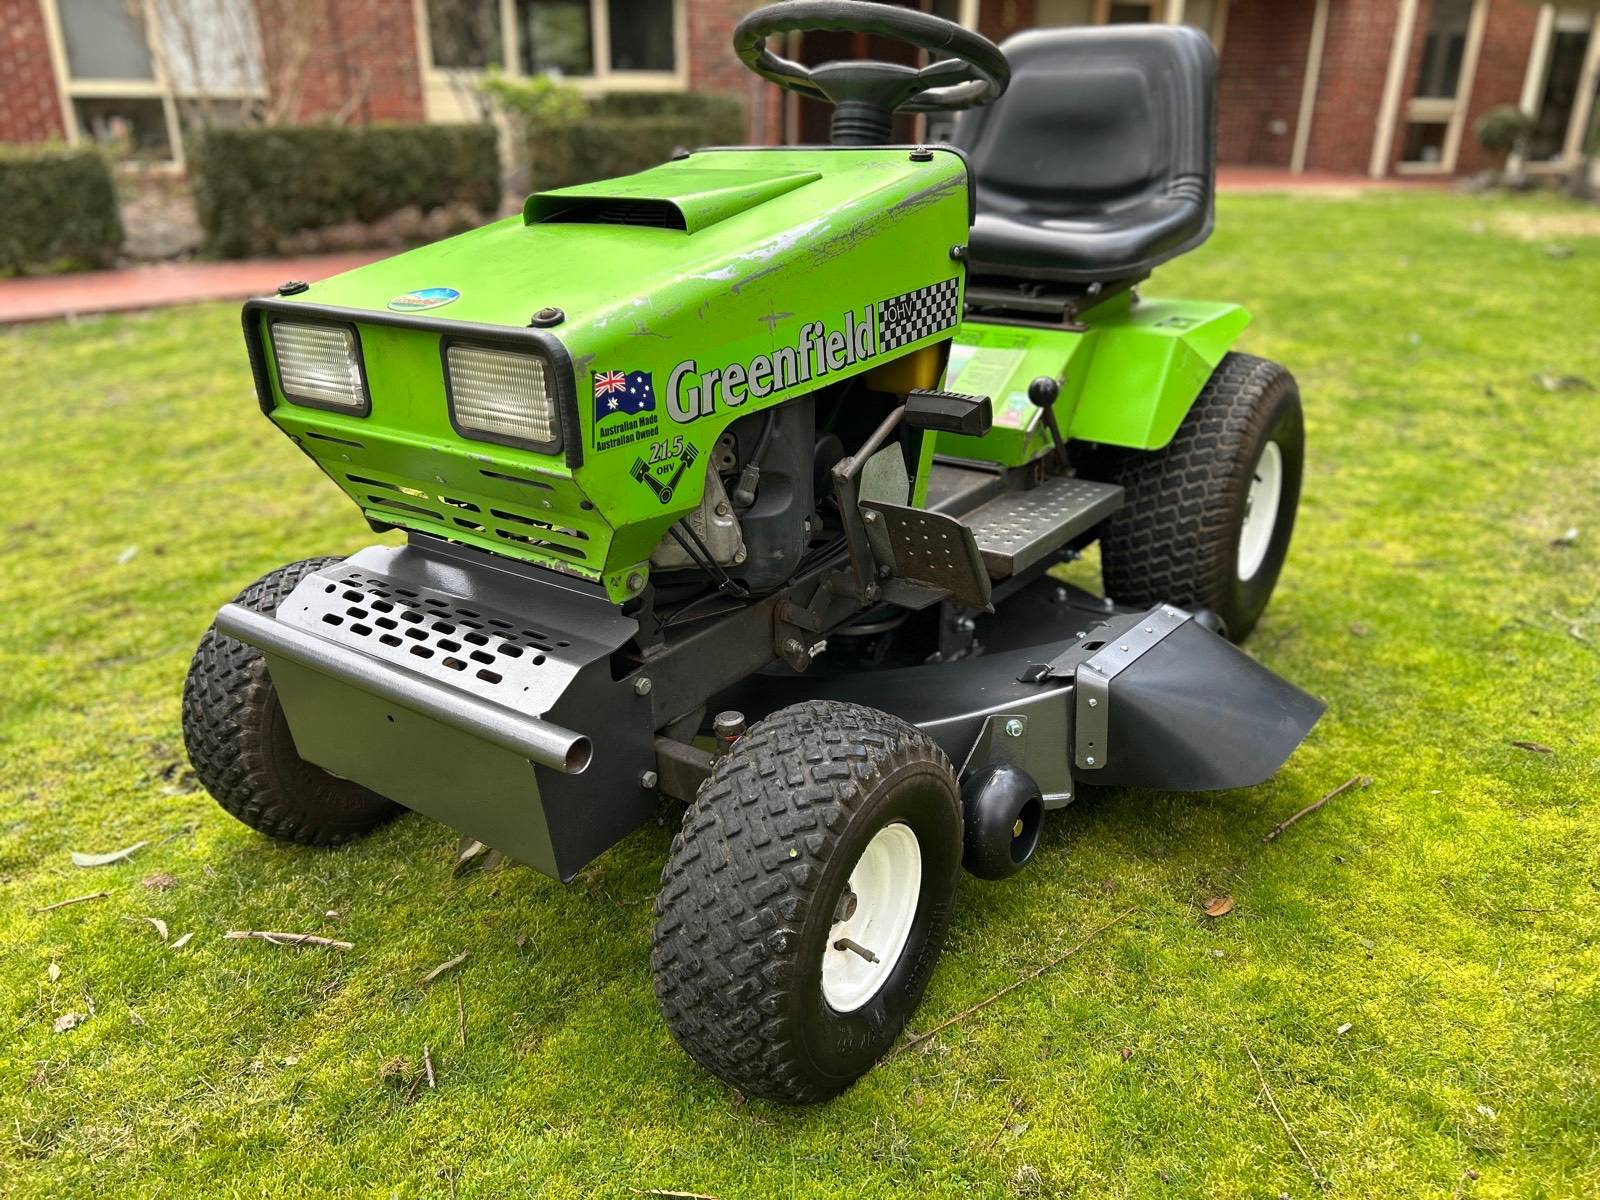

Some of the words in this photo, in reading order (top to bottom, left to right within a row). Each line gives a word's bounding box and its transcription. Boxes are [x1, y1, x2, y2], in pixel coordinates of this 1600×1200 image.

[887, 300, 913, 323] OHV
[666, 304, 875, 424] Greenfield
[597, 433, 635, 452] Australian
[635, 425, 659, 440] Owned
[600, 421, 638, 438] Australian
[639, 414, 658, 427] Made
[648, 435, 684, 464] 21.5
[656, 463, 675, 475] OHV
